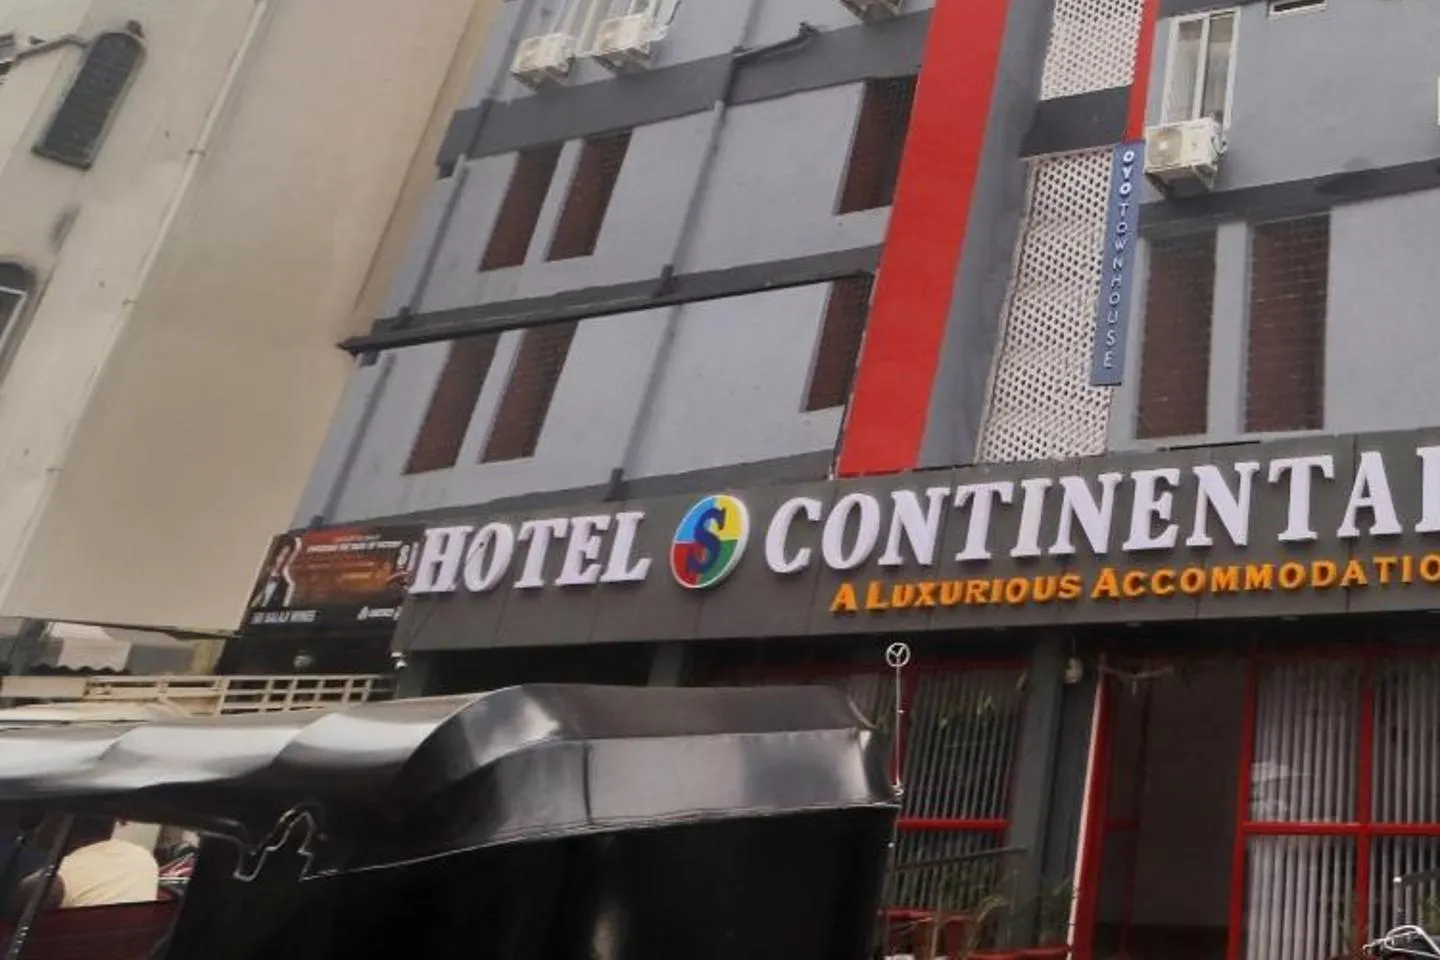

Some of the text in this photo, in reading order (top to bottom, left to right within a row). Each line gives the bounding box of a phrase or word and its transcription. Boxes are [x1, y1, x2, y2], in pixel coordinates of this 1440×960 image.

[1103, 150, 1135, 368] OYO TOWNHOUSE
[407, 511, 652, 594] HOTEL
[830, 582, 858, 612] A
[864, 571, 1081, 611] LUXURIOUS
